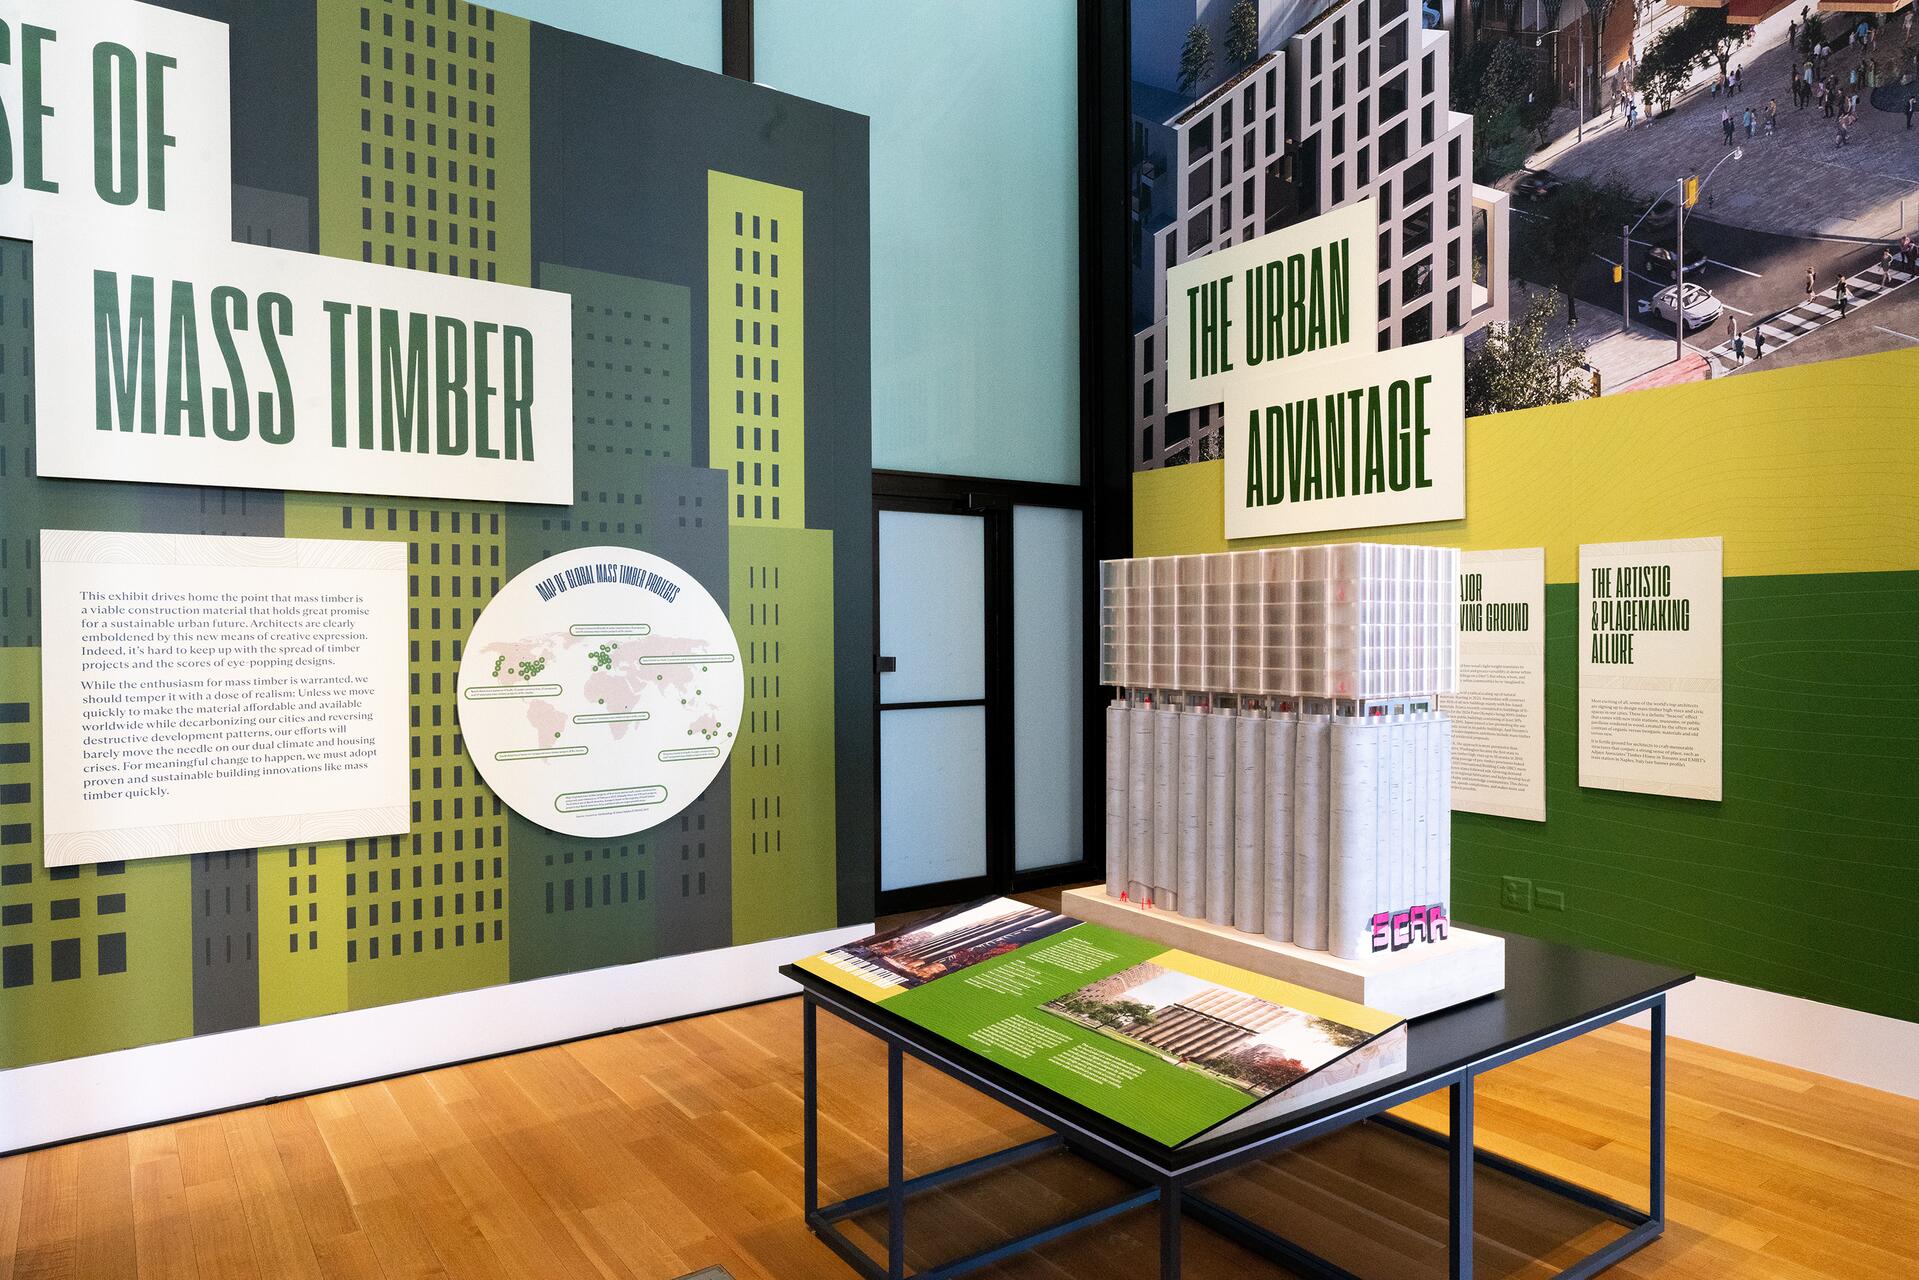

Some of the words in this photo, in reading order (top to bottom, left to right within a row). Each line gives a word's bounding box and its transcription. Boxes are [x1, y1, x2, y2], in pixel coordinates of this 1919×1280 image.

[93, 41, 177, 211] OF
[1187, 275, 1233, 380] THE
[1246, 238, 1350, 366] URBAN
[94, 269, 295, 445] MASS
[323, 300, 535, 462] TIMBER
[1246, 375, 1432, 508] ADVANTAGE
[535, 577, 557, 602] MAP
[554, 572, 568, 593] OF
[565, 565, 595, 589] GLOBAL
[595, 563, 617, 583] MASS
[619, 564, 647, 588] TIMBER
[644, 572, 680, 603] PROJECTS
[1592, 568, 1612, 598] THE
[1616, 565, 1671, 597] ARTISTIC
[79, 591, 105, 600] This
[108, 591, 147, 600] exhibit
[151, 592, 185, 601] drives
[188, 592, 218, 601] home
[221, 593, 238, 601] the
[241, 593, 267, 603] point
[271, 593, 290, 602] that
[321, 594, 353, 602] timber
[355, 594, 363, 602] is
[90, 605, 125, 614] viable
[127, 606, 199, 614] construction
[202, 606, 246, 614] material
[249, 606, 269, 615] that
[272, 606, 300, 615] holds
[302, 608, 327, 616] great
[330, 607, 369, 616] promise
[1486, 602, 1529, 632] GROUND
[1591, 600, 1599, 632] &
[1601, 599, 1690, 631] PLACEMAKING
[81, 618, 99, 627] for
[110, 618, 174, 628] sustainable
[177, 619, 209, 627] urban
[212, 619, 248, 627] future.
[250, 619, 303, 627] Architects
[322, 619, 353, 629] clearly
[81, 632, 153, 641] emboldened
[157, 632, 170, 643] by
[173, 632, 193, 641] this
[256, 631, 268, 640] of
[270, 631, 310, 640] creative
[312, 631, 367, 641] expression.
[81, 646, 125, 655] Indeed,
[147, 645, 172, 654] hard
[189, 645, 215, 655] keep
[218, 647, 231, 655] up
[234, 644, 257, 653] with
[259, 644, 276, 653] the
[278, 644, 312, 655] spread
[314, 644, 324, 652] of
[327, 643, 360, 652] timber
[1592, 633, 1634, 664] ALLURE
[82, 660, 129, 671] projects
[131, 659, 152, 668] and
[156, 659, 173, 668] the
[213, 657, 224, 666] of
[226, 657, 293, 668] eye-popping
[295, 657, 335, 666] designs.
[80, 680, 115, 690] While
[118, 680, 137, 689] the
[139, 679, 203, 688] enthusiasm
[206, 678, 222, 686] for
[253, 676, 288, 685] timber
[290, 676, 297, 684] is
[300, 674, 353, 684] warranted,
[82, 693, 121, 704] should
[125, 694, 165, 703] temper
[168, 692, 175, 701] it
[178, 691, 202, 700] with
[214, 690, 239, 699] dose
[241, 689, 252, 698] of
[298, 688, 330, 697] Unless
[82, 707, 126, 719] quickly
[128, 708, 140, 716] to
[143, 705, 173, 715] make
[175, 705, 193, 714] the
[196, 703, 240, 713] material
[243, 701, 295, 711] affordable
[298, 700, 316, 709] and
[319, 699, 361, 709] available
[81, 720, 143, 731] worldwide
[146, 719, 176, 728] while
[178, 716, 256, 727] decarbonizing
[278, 714, 305, 723] cities
[307, 712, 325, 722] and
[328, 711, 373, 721] reversing
[82, 734, 148, 745] destructive
[150, 731, 222, 742] development
[226, 730, 272, 740] patterns,
[293, 725, 326, 735] efforts
[328, 724, 346, 733] will
[83, 748, 119, 759] barely
[122, 748, 153, 757] move
[156, 746, 173, 755] the
[176, 743, 212, 754] needle
[251, 740, 274, 750] dual
[276, 740, 313, 748] climate
[316, 737, 334, 746] and
[336, 736, 375, 745] housing
[83, 763, 119, 772] crises.
[123, 761, 142, 770] For
[145, 756, 207, 769] meaningful
[210, 756, 248, 765] change
[264, 753, 305, 763] happen,
[349, 748, 376, 758] adopt
[83, 777, 124, 788] proven
[127, 773, 148, 784] and
[151, 770, 213, 782] sustainable
[216, 767, 260, 778] building
[262, 764, 322, 775] innovations
[324, 762, 341, 771] like
[83, 790, 122, 800] timber
[124, 786, 169, 799] quickly.
